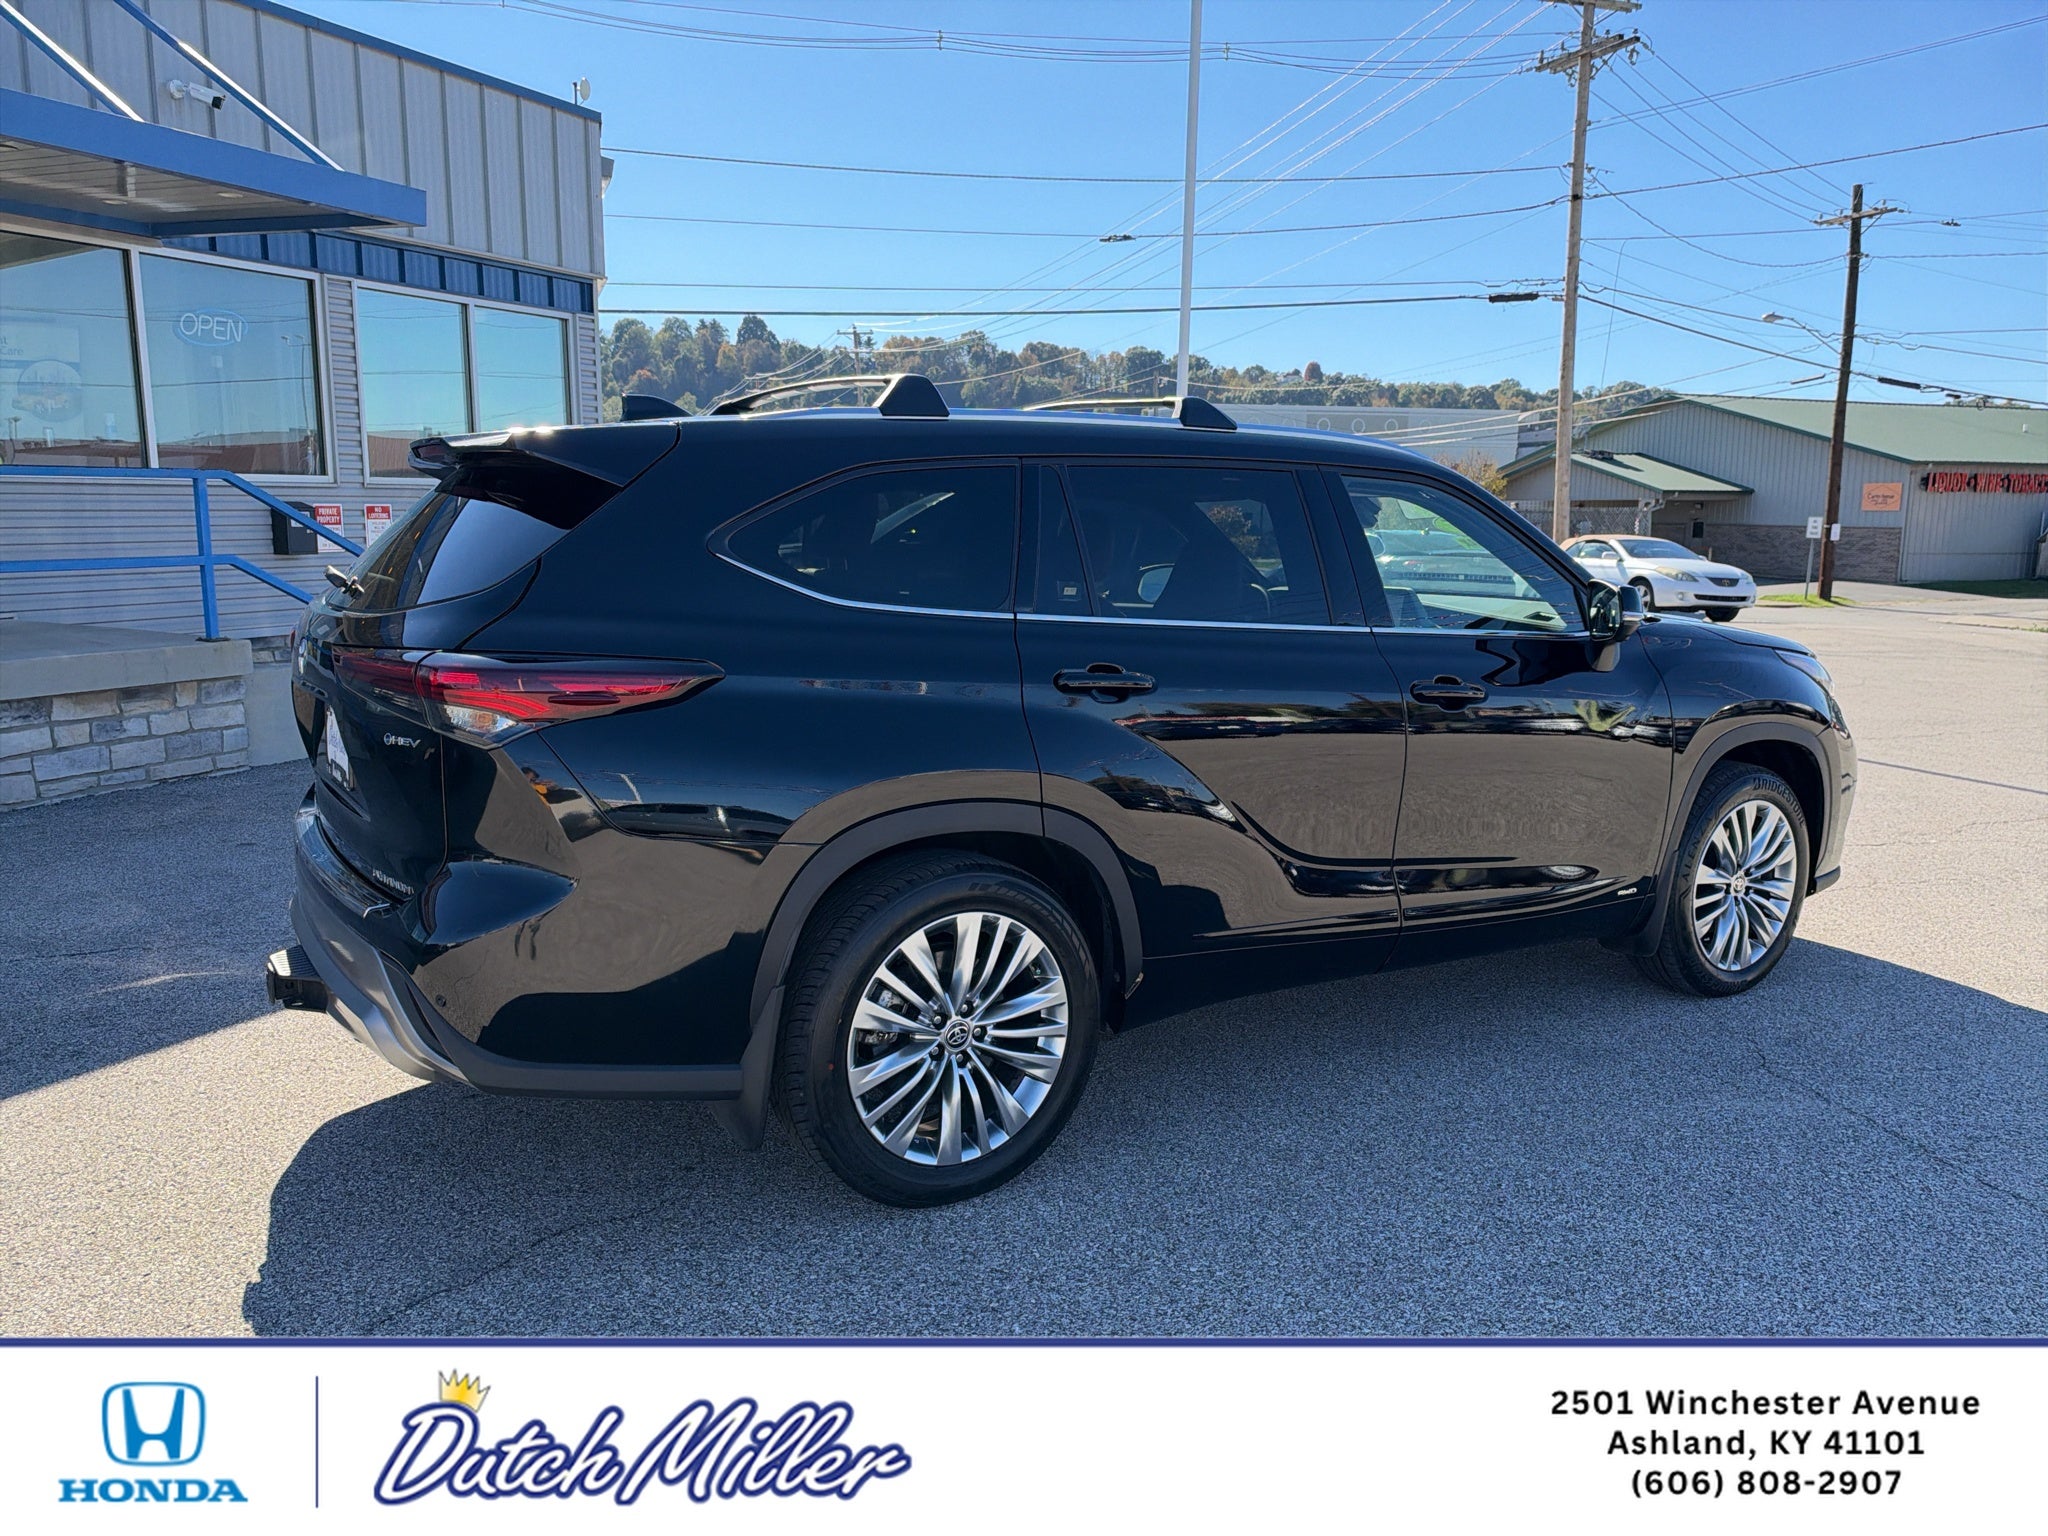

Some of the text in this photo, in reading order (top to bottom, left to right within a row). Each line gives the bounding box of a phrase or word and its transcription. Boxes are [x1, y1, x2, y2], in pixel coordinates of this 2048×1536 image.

[180, 312, 242, 342] OPEN
[1926, 472, 1968, 493] LIQUOR
[1976, 473, 2003, 493] WINE
[316, 516, 340, 524] PROPERTY
[318, 507, 338, 515] PRIVATE
[1752, 777, 1806, 829] BRIDGESTONE
